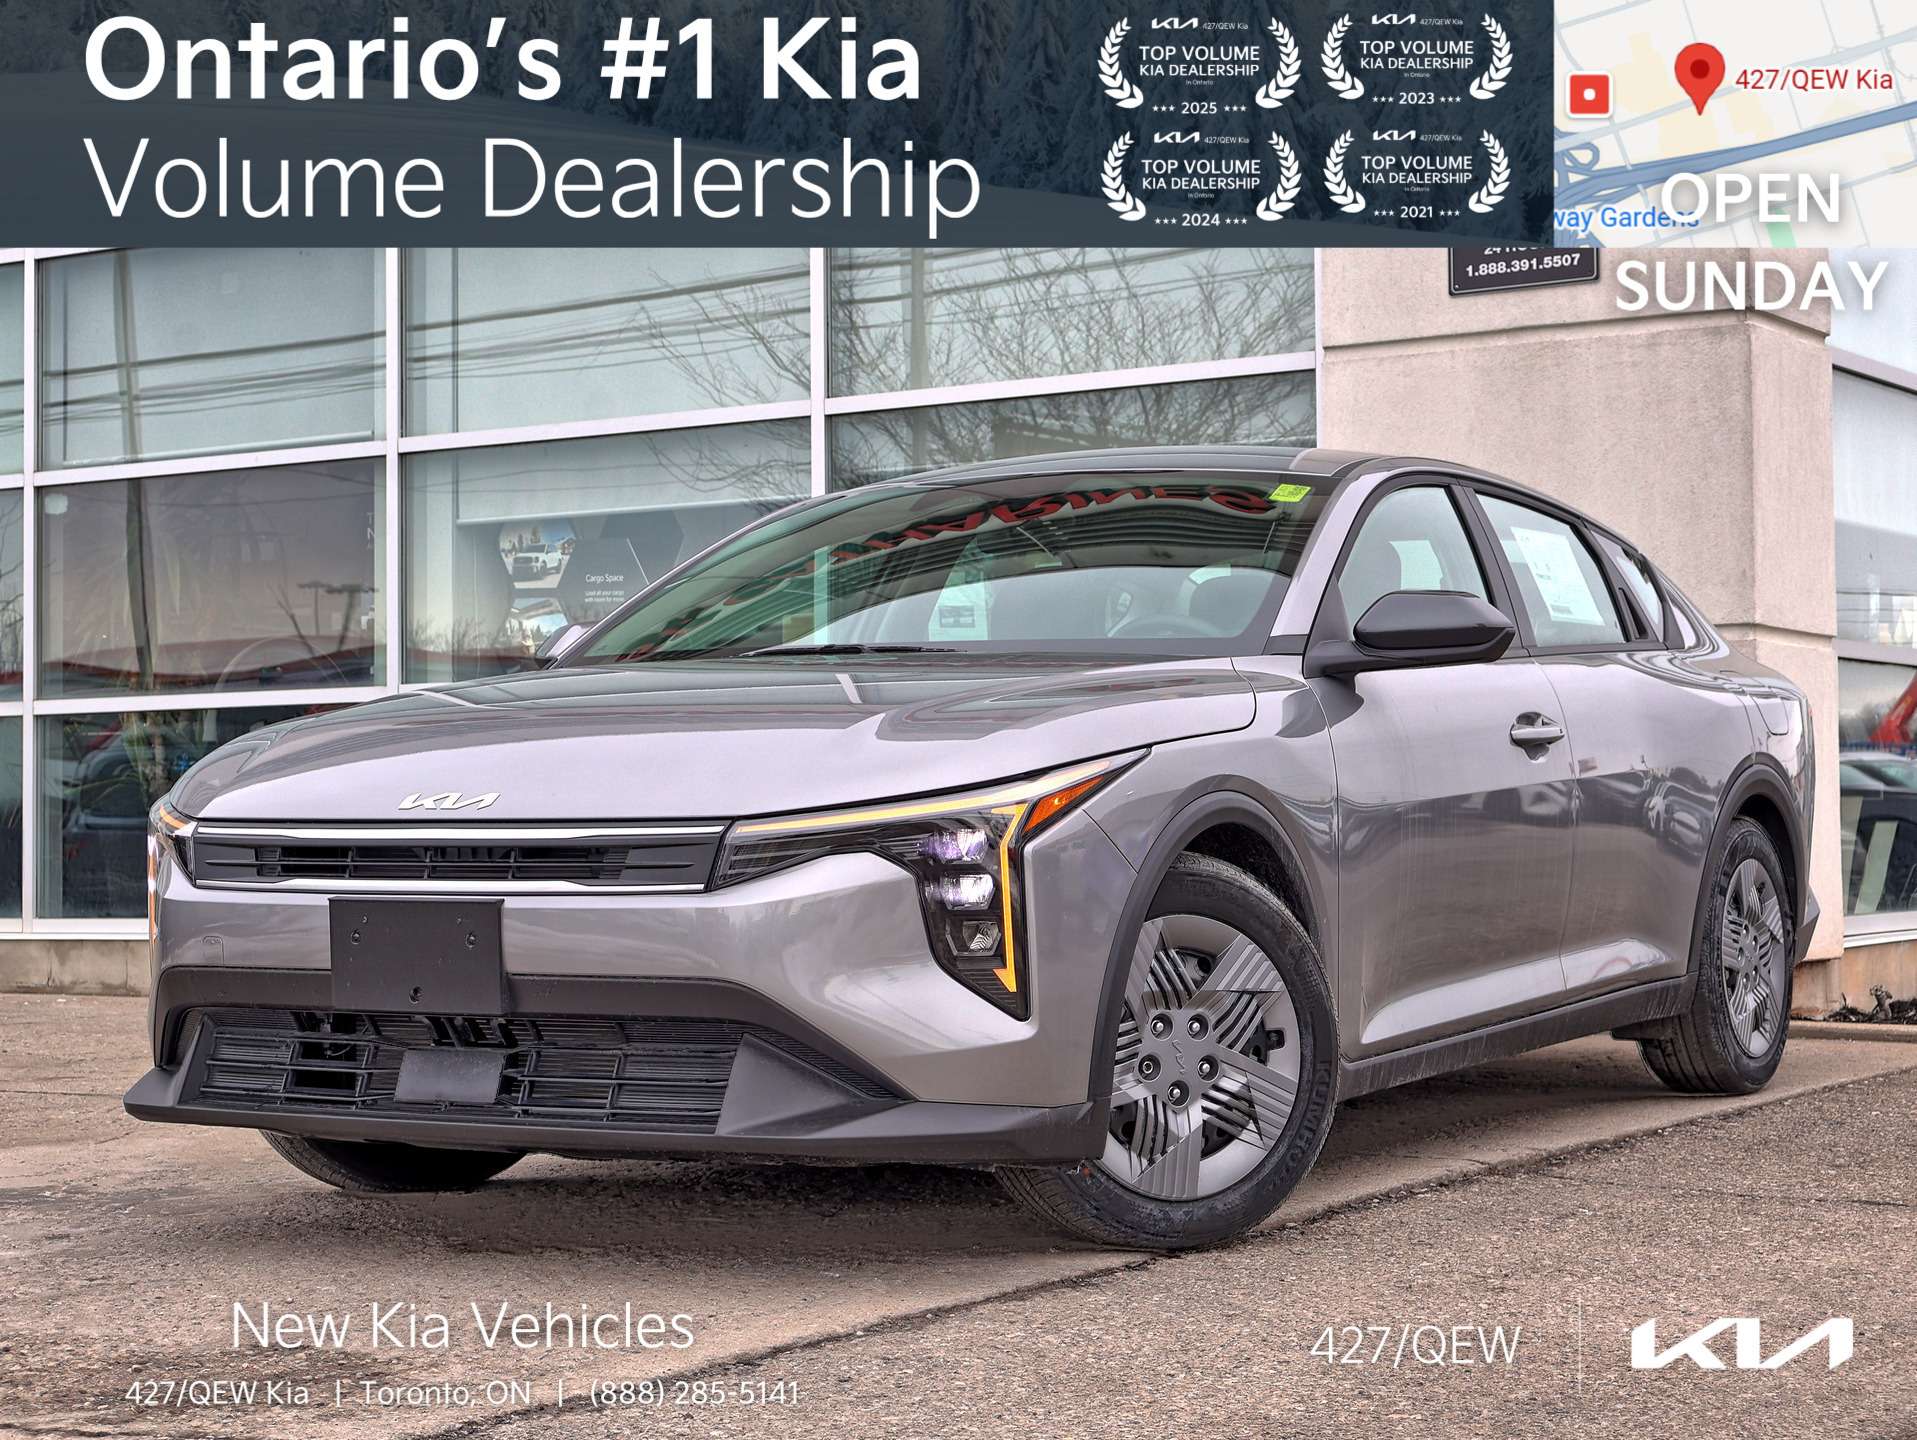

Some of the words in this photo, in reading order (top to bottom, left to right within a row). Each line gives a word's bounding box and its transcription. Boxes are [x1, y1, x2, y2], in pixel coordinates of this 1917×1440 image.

[1466, 253, 1581, 277] 1.888.391.5507
[585, 574, 604, 584] Cargo
[605, 573, 624, 583] Space
[398, 792, 501, 810] KIA
